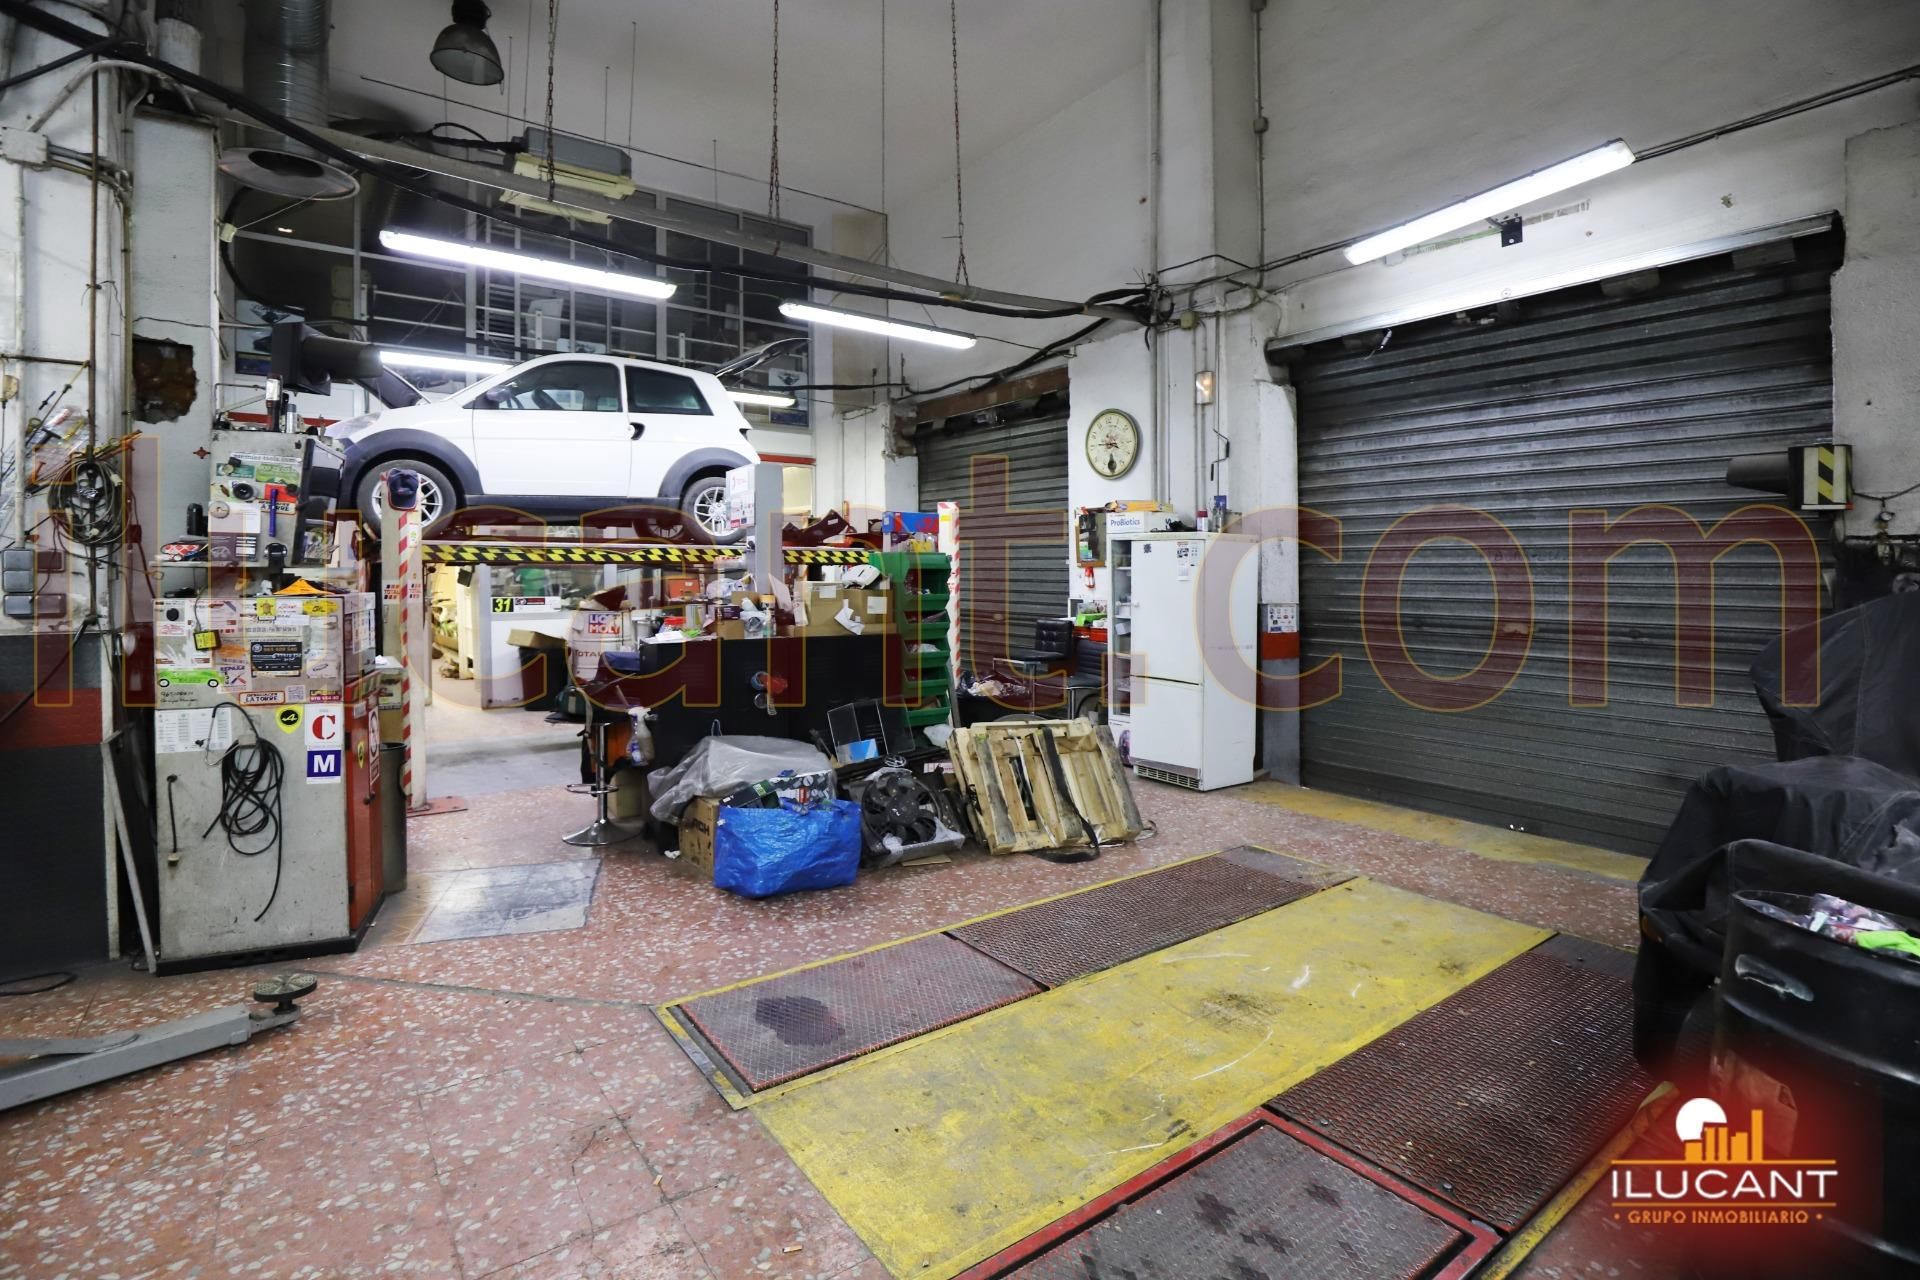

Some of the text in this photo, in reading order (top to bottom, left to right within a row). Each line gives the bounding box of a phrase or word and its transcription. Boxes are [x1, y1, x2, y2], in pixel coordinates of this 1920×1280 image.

[1110, 518, 1141, 527] ProBiotics
[494, 598, 512, 613] 31
[589, 624, 621, 634] MOLY
[311, 714, 336, 741] C
[313, 754, 336, 773] M
